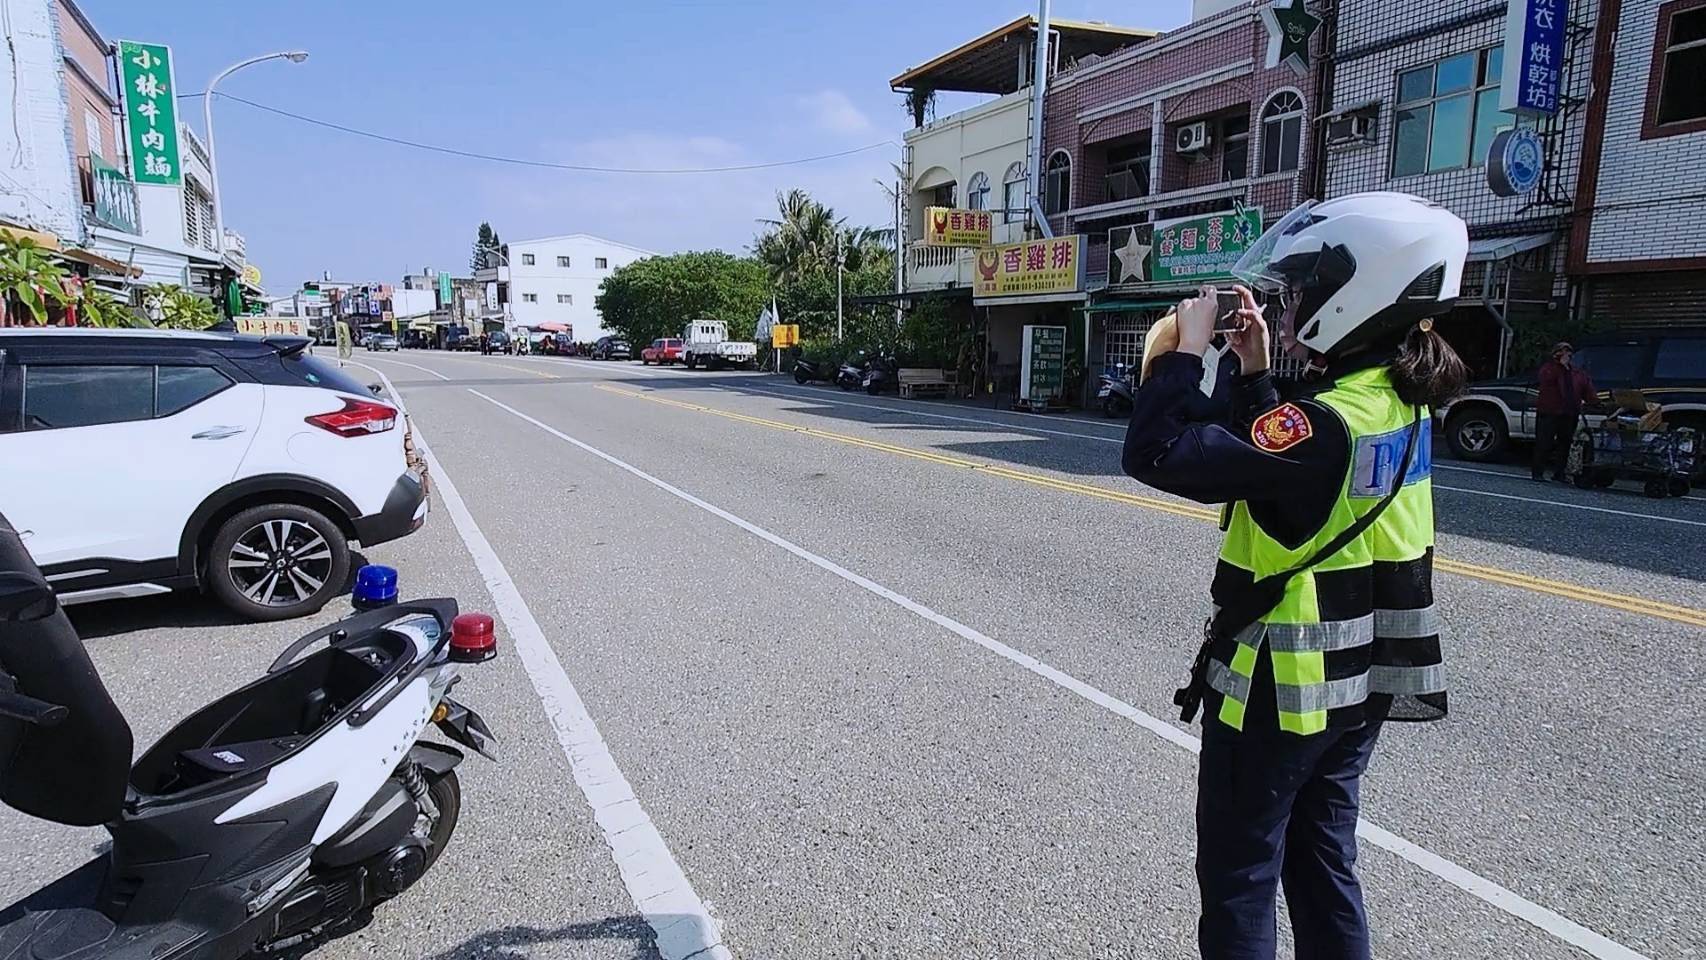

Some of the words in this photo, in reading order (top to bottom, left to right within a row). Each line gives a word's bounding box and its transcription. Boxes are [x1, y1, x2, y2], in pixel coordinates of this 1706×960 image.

[132, 50, 171, 177] 小林牛肉麵
[951, 213, 988, 231] 香雞排
[1004, 241, 1072, 273] 香雞排
